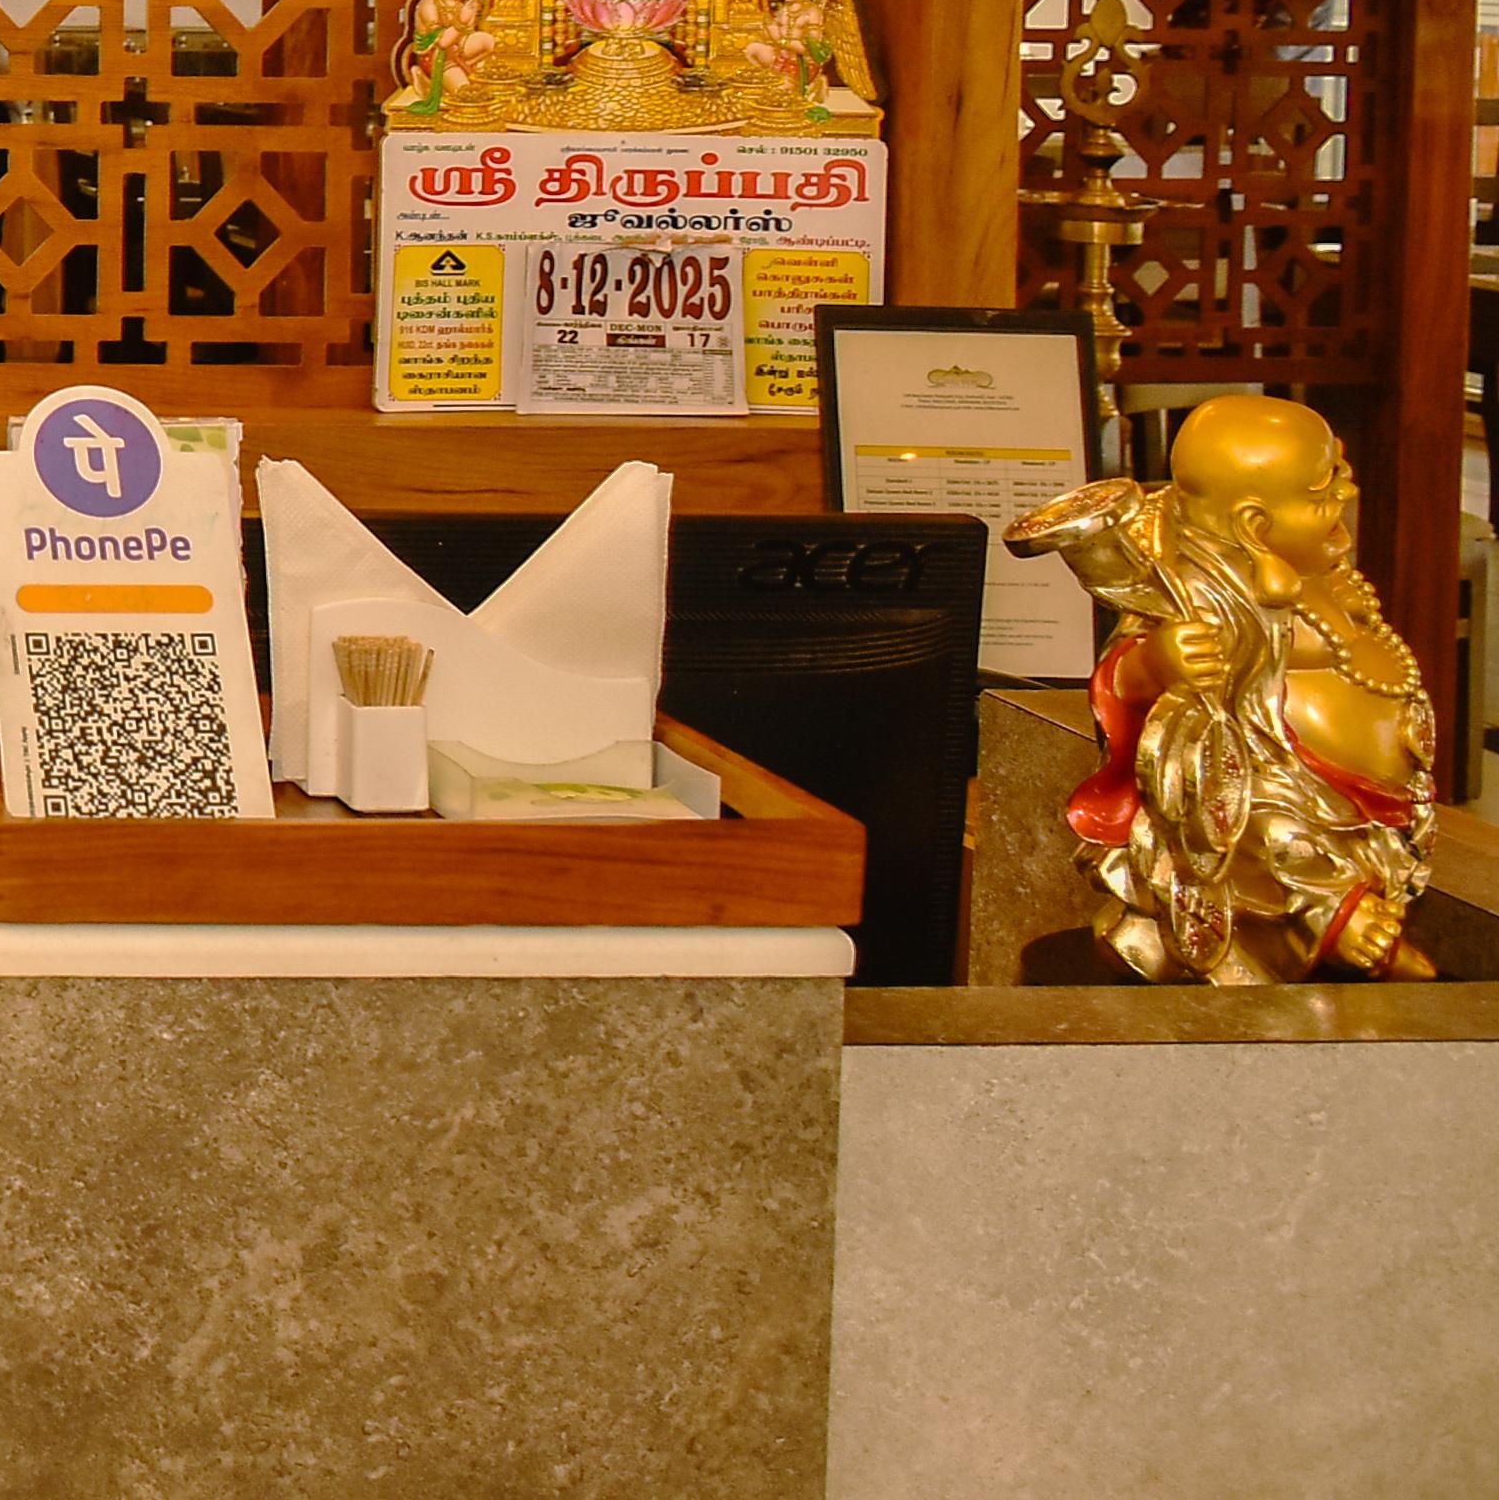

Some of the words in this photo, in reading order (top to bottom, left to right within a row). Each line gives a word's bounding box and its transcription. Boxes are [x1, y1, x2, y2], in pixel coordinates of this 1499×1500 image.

[780, 148, 818, 156] 91501
[823, 148, 868, 156] 32950
[534, 152, 870, 212] திருப்பதி
[415, 280, 429, 288] BIS
[431, 280, 452, 288] HALL
[455, 280, 480, 288] MARK
[401, 292, 451, 306] புத்தம்
[457, 292, 495, 306] புதிய
[609, 323, 663, 332] DEC-MON
[556, 329, 579, 345] 22
[687, 333, 711, 348] 17
[64, 414, 125, 498] पे
[24, 527, 192, 562] PhonePe
[737, 538, 941, 593] acer
